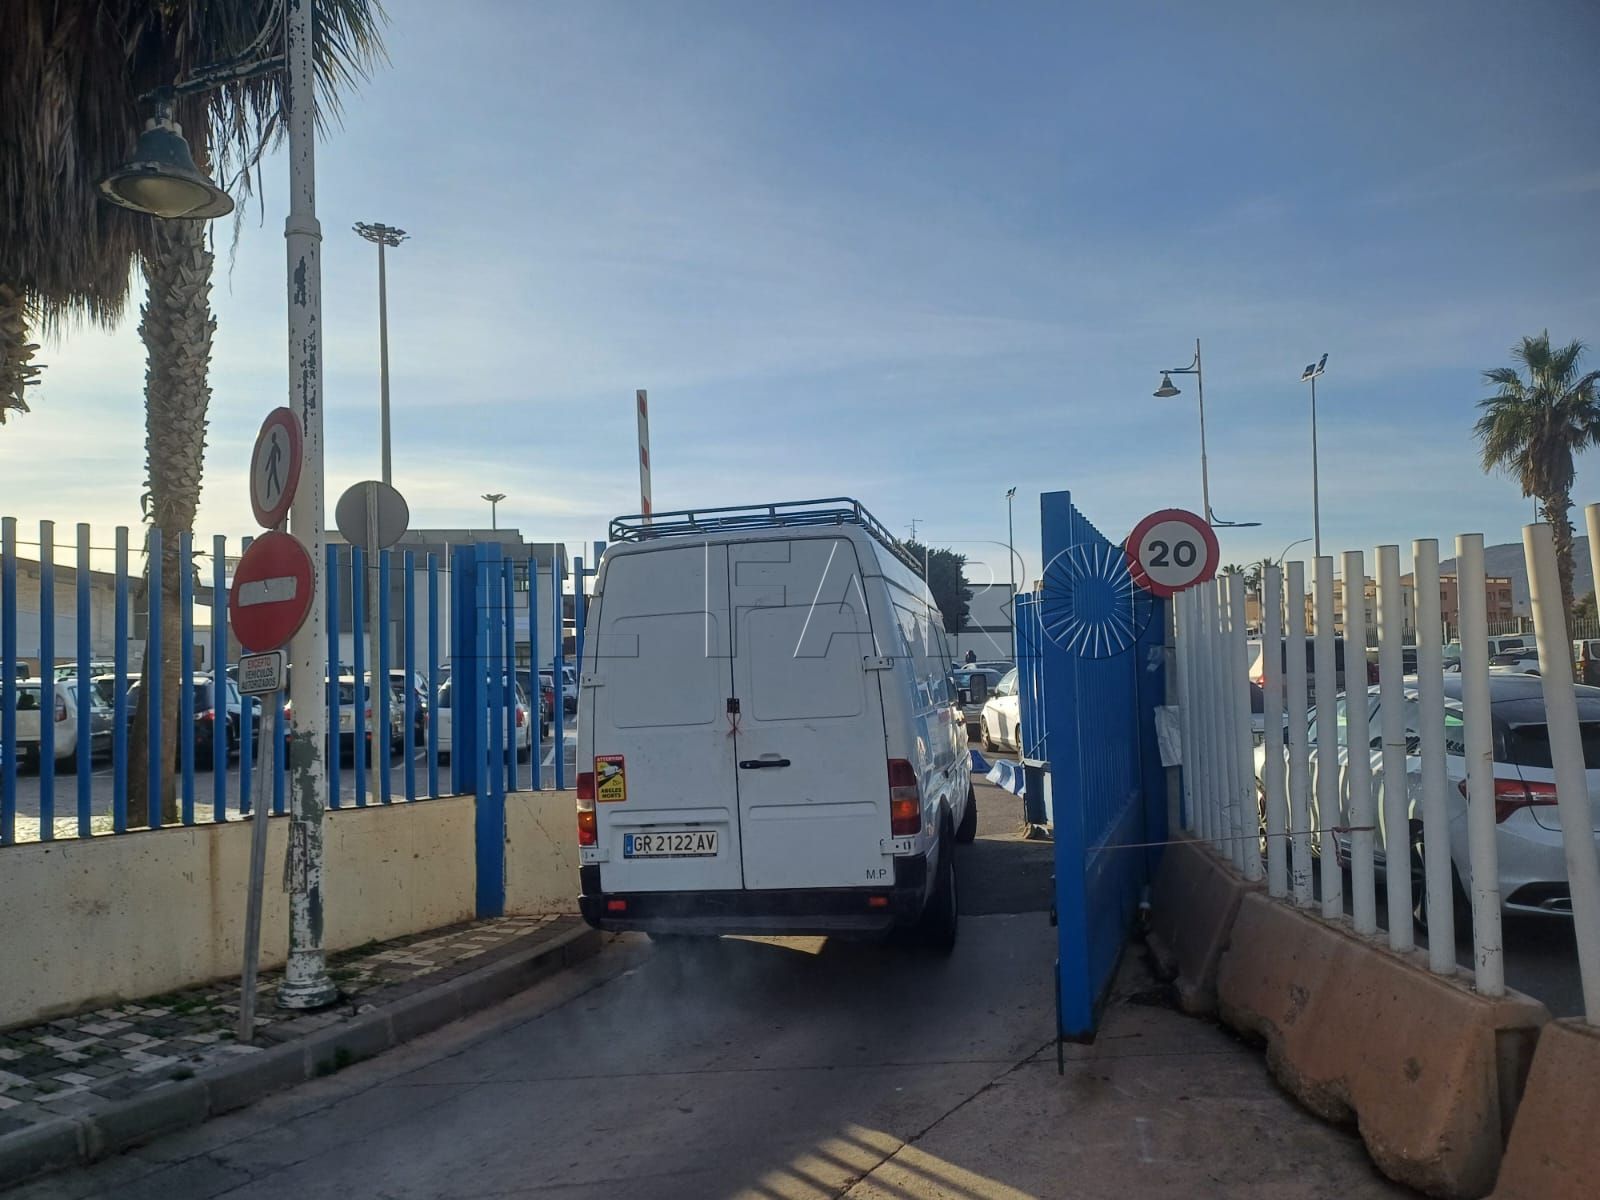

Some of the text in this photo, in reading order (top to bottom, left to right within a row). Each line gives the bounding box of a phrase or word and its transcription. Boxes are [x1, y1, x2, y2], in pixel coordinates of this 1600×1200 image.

[1148, 540, 1197, 568] 20
[247, 656, 272, 669] EXCEPTO
[241, 677, 276, 690] AUTORIZADOS
